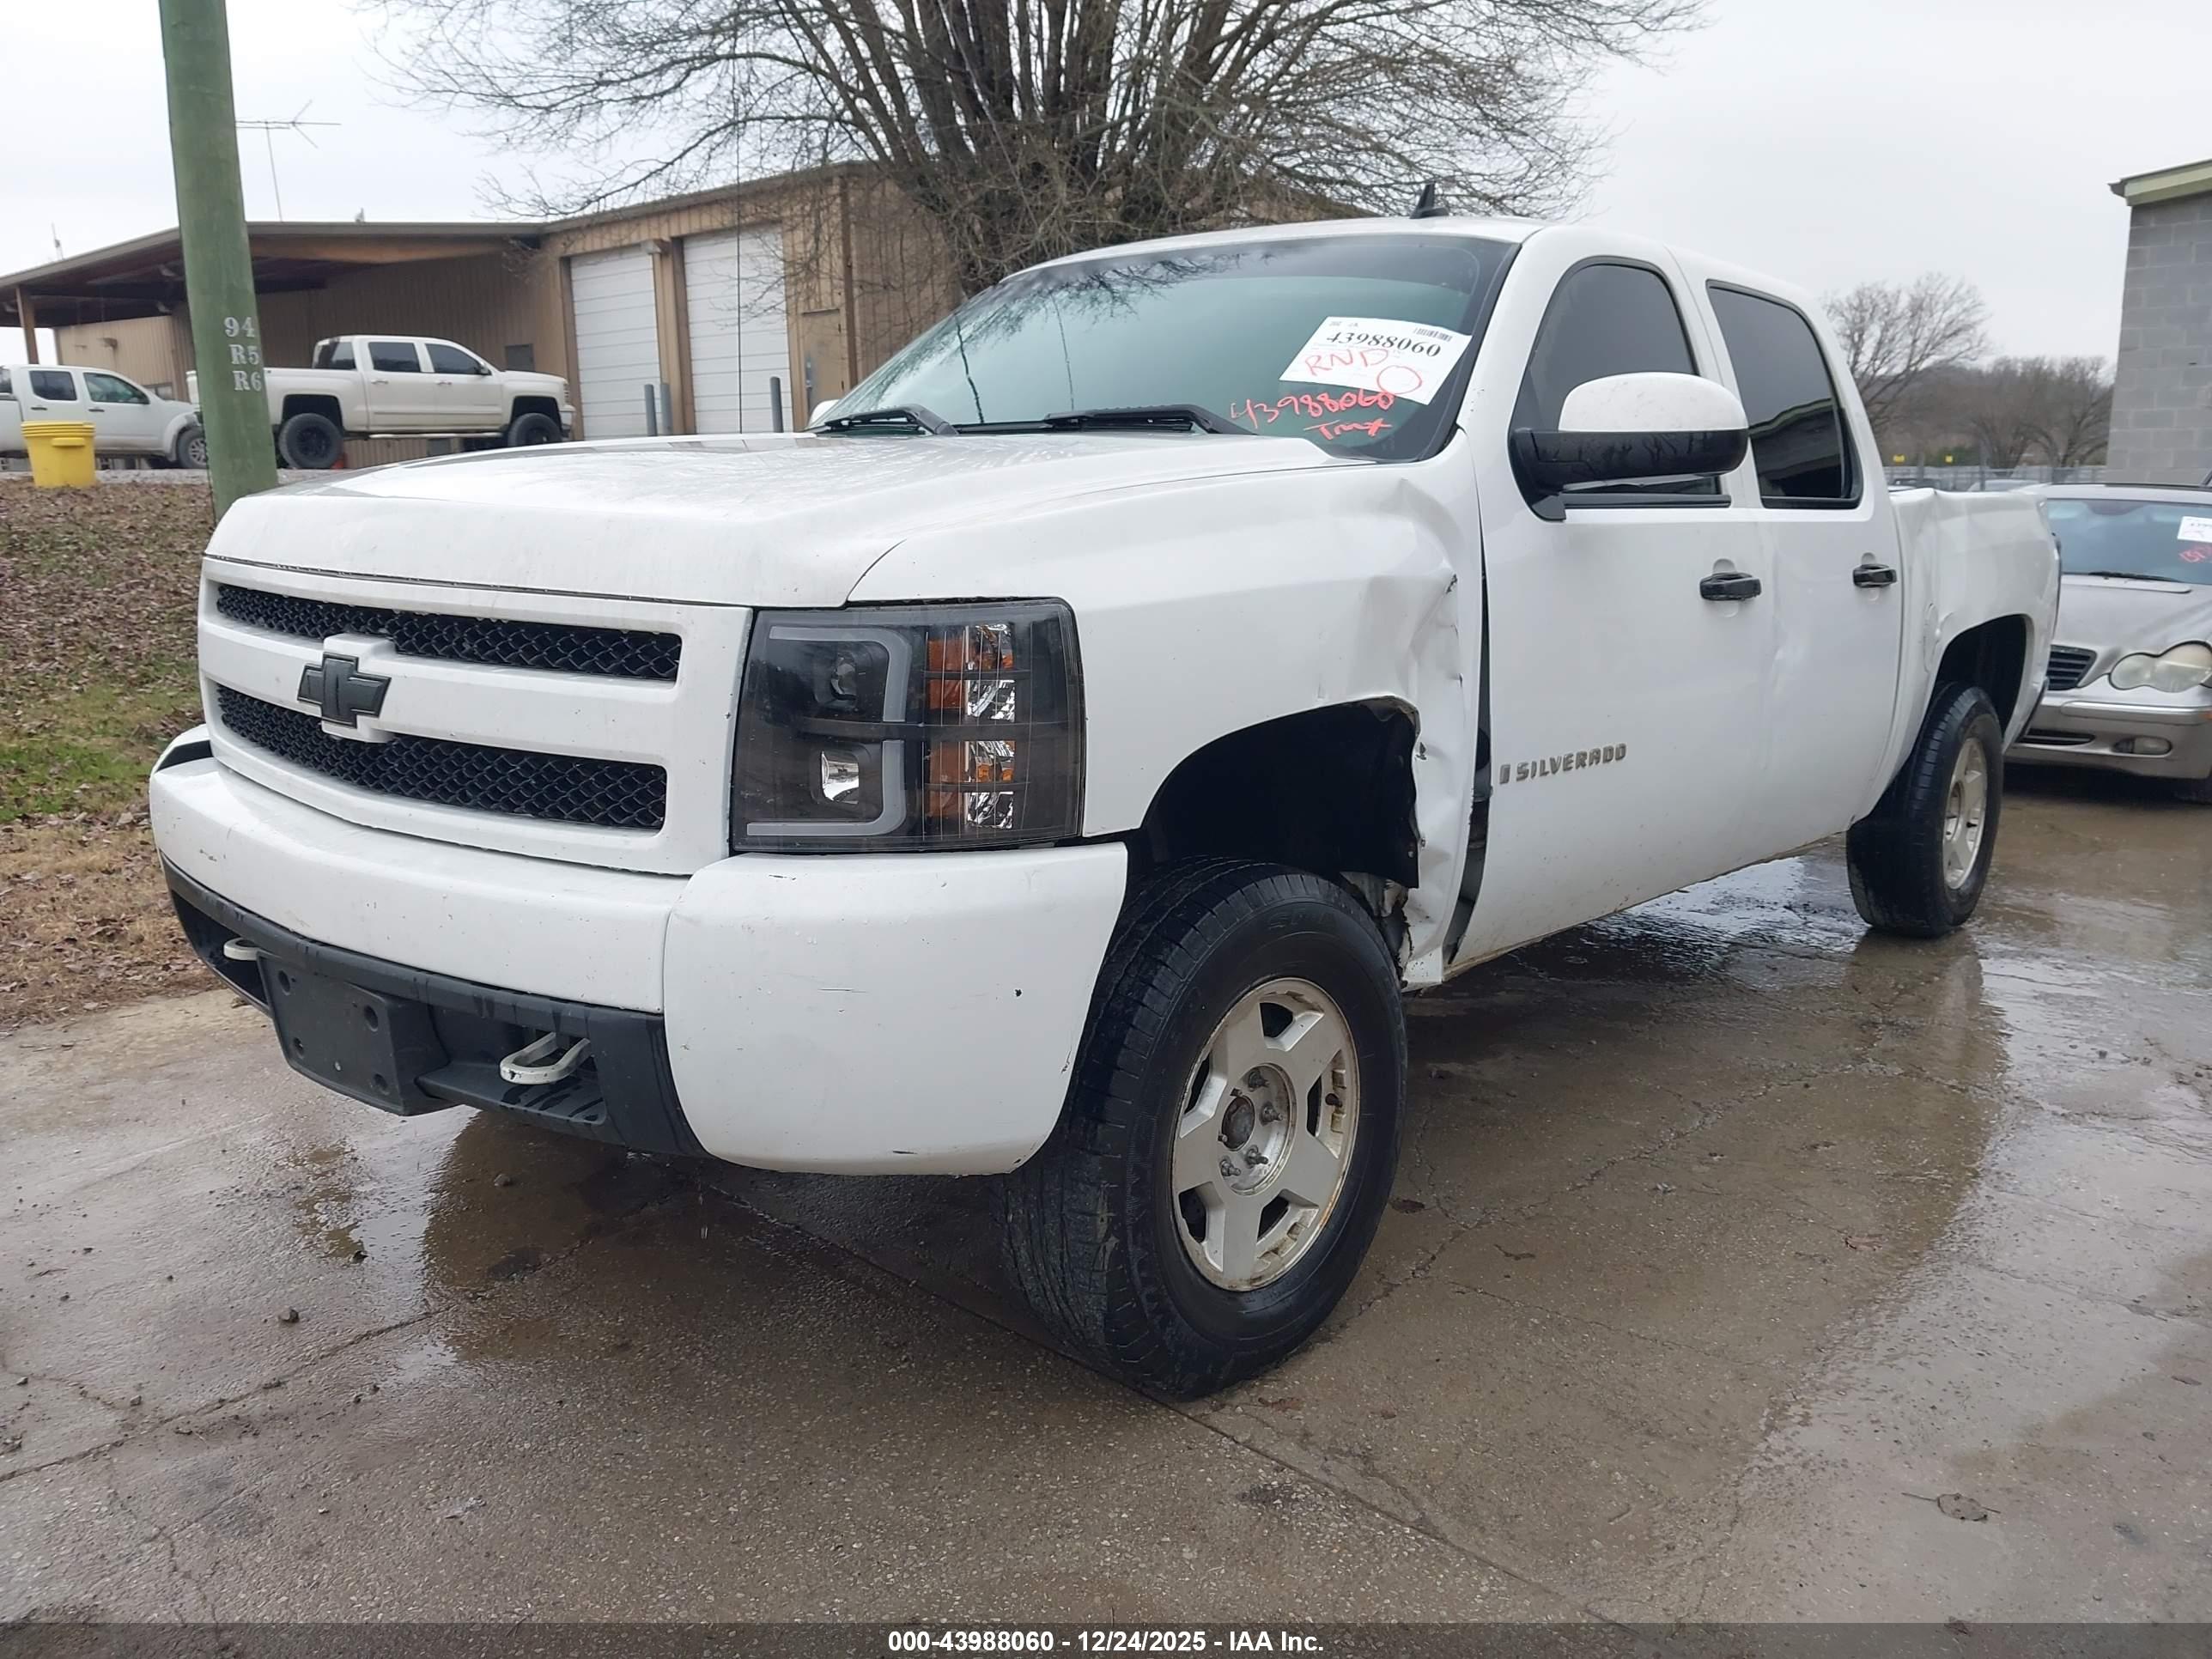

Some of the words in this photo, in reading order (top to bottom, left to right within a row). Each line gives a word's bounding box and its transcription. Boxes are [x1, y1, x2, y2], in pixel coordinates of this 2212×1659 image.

[223, 316, 256, 337] 94
[228, 343, 260, 366] R5
[1326, 331, 1442, 357] 43988060
[232, 370, 263, 392] R6
[1230, 387, 1397, 429] 43988060
[1516, 743, 1627, 782] SILVERADO
